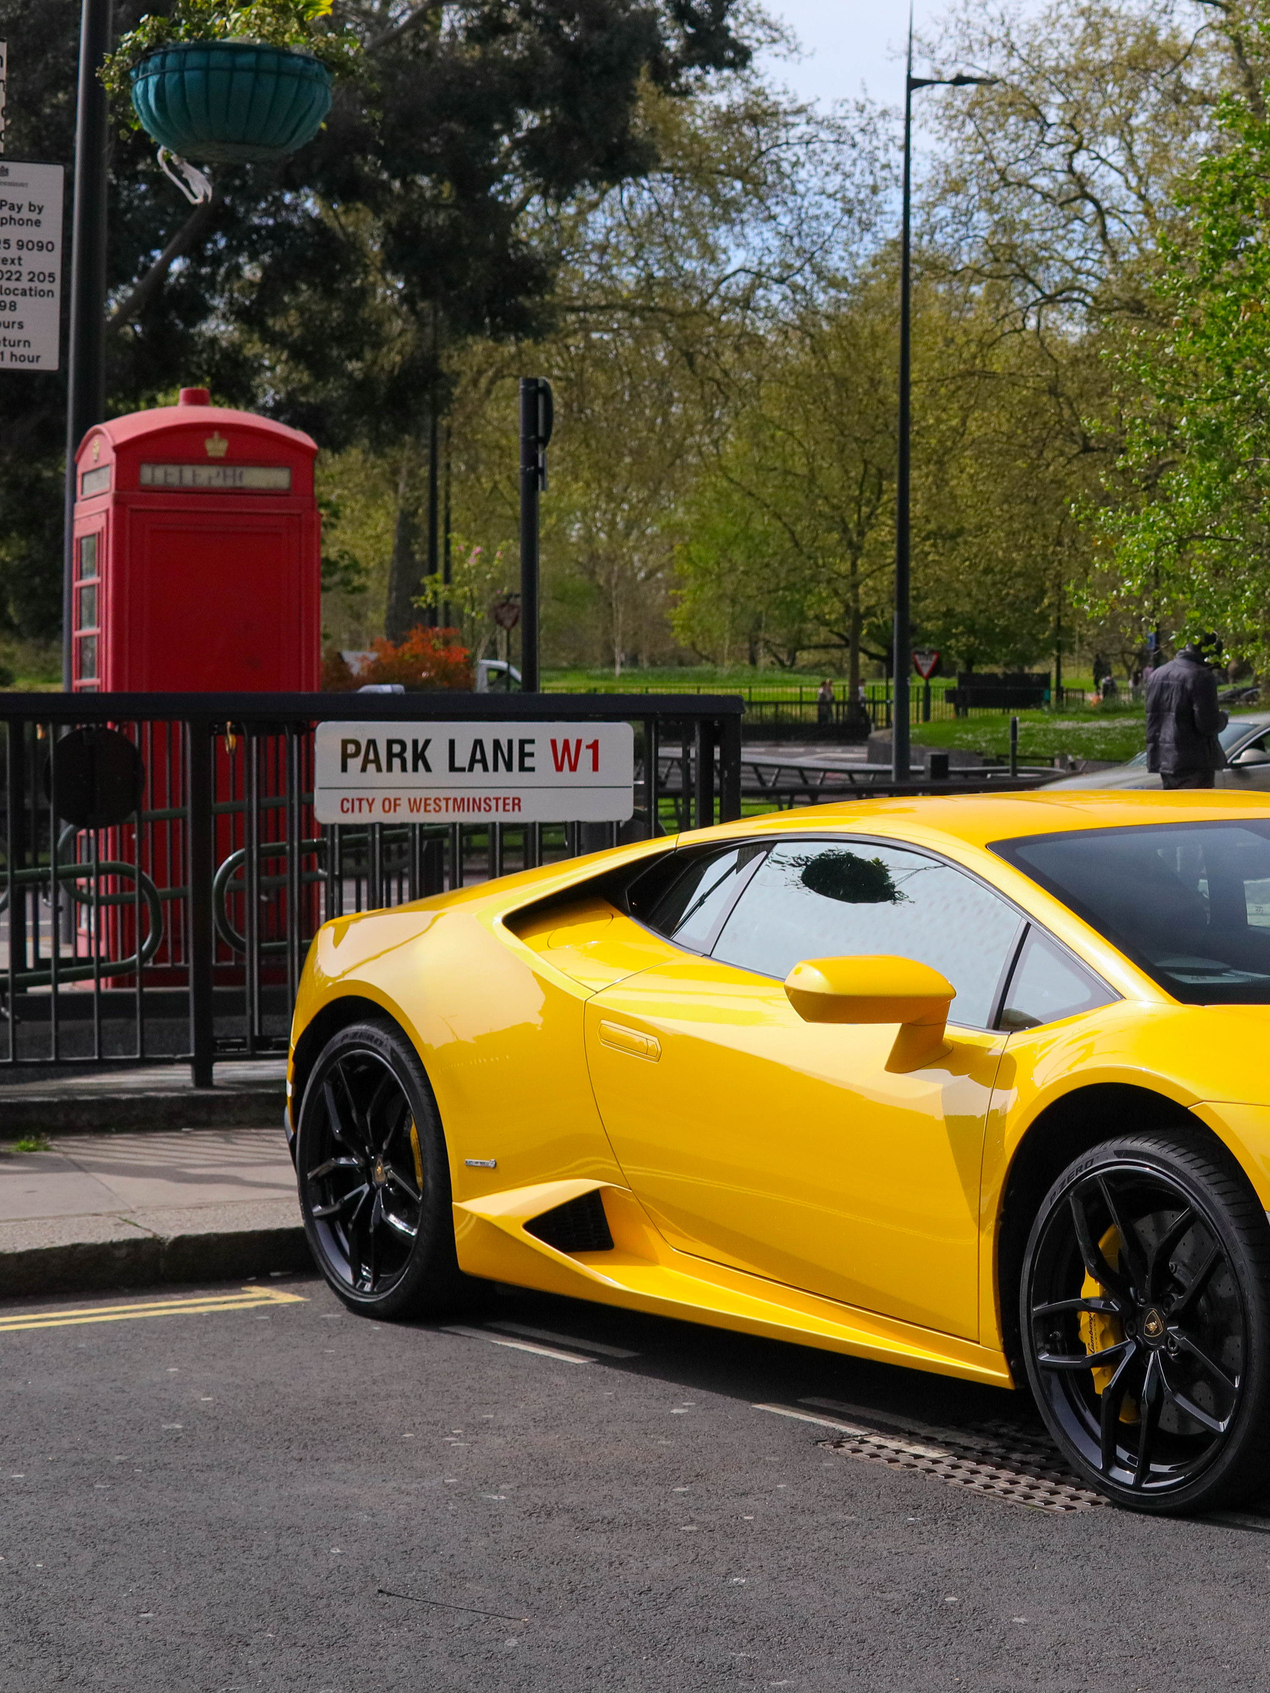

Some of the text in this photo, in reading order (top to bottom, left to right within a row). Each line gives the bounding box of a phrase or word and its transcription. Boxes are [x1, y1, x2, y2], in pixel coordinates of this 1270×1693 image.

[0, 200, 44, 214] Pay by
[0, 215, 41, 228] phone
[16, 239, 55, 252] 9090
[1, 255, 23, 266] ext
[27, 271, 56, 283] 205
[0, 320, 24, 330] urs
[0, 337, 31, 348] turn
[10, 351, 41, 363] hour
[340, 738, 600, 773] PARK LANE W1
[340, 796, 522, 814] CITY OF WESTMINSTER
